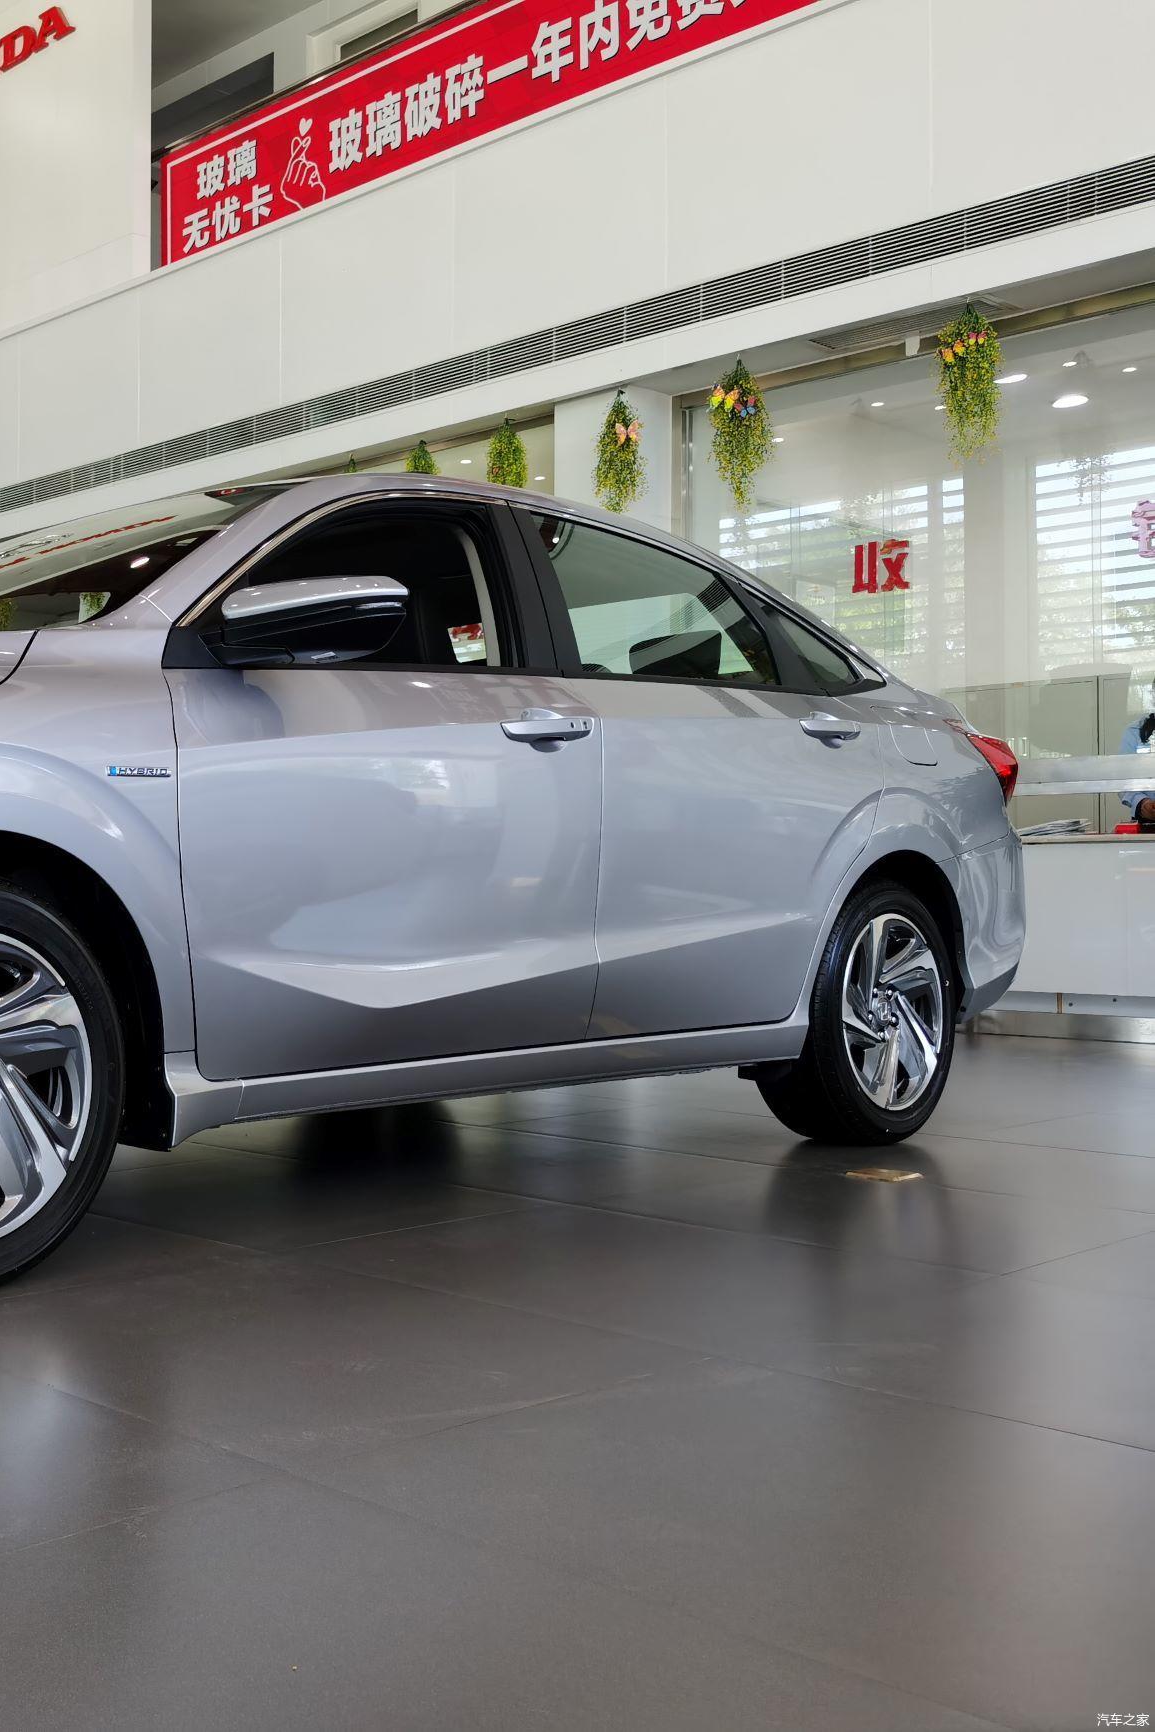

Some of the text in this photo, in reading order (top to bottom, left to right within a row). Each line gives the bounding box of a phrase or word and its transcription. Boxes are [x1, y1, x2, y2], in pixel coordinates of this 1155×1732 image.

[328, 0, 746, 174] 玻璃破碎一年内免
[196, 139, 258, 200] 玻璃
[182, 184, 274, 254] 无忧卡
[118, 766, 169, 776] HYBRID
